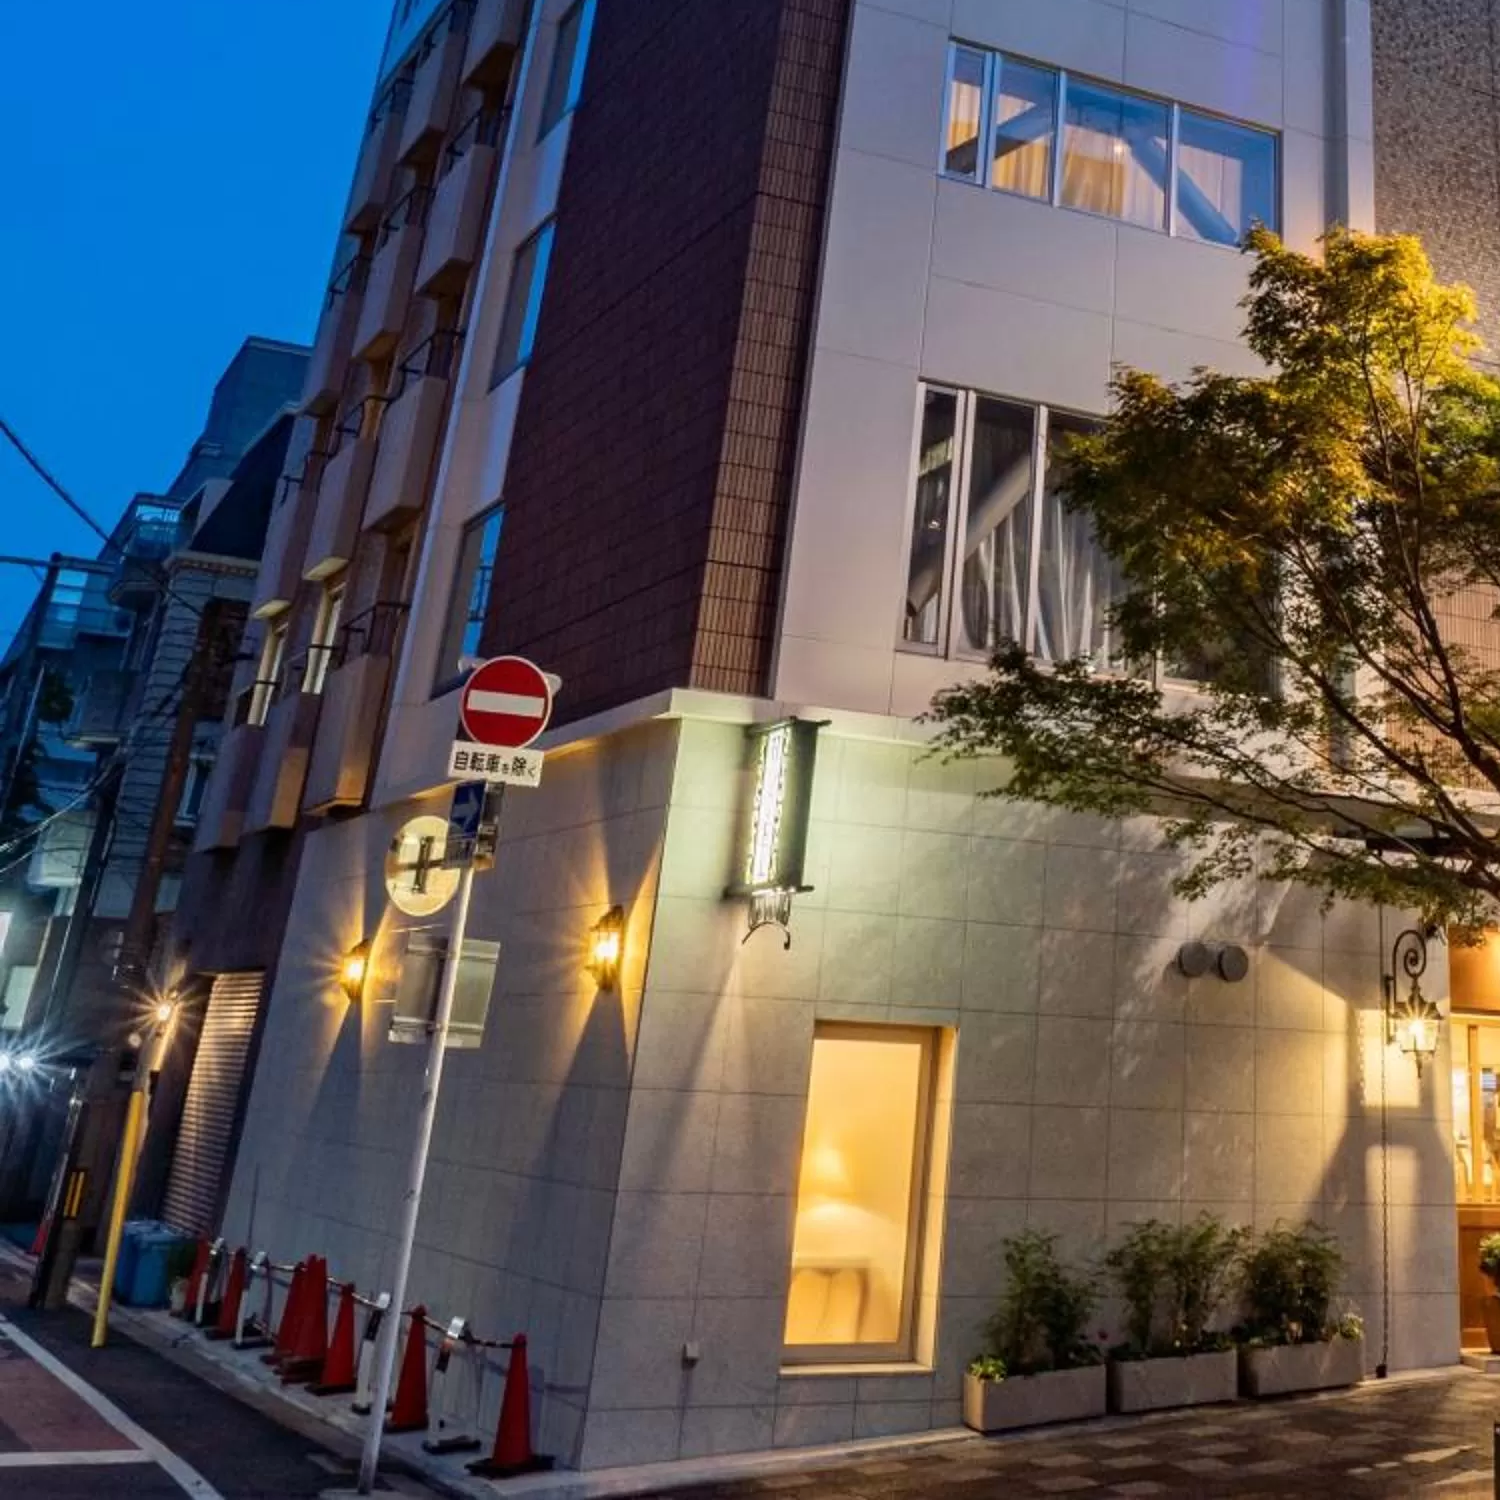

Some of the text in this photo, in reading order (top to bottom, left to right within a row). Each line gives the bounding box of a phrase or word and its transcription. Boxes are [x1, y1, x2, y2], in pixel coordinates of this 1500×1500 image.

[454, 750, 537, 778] 自転車を除く
